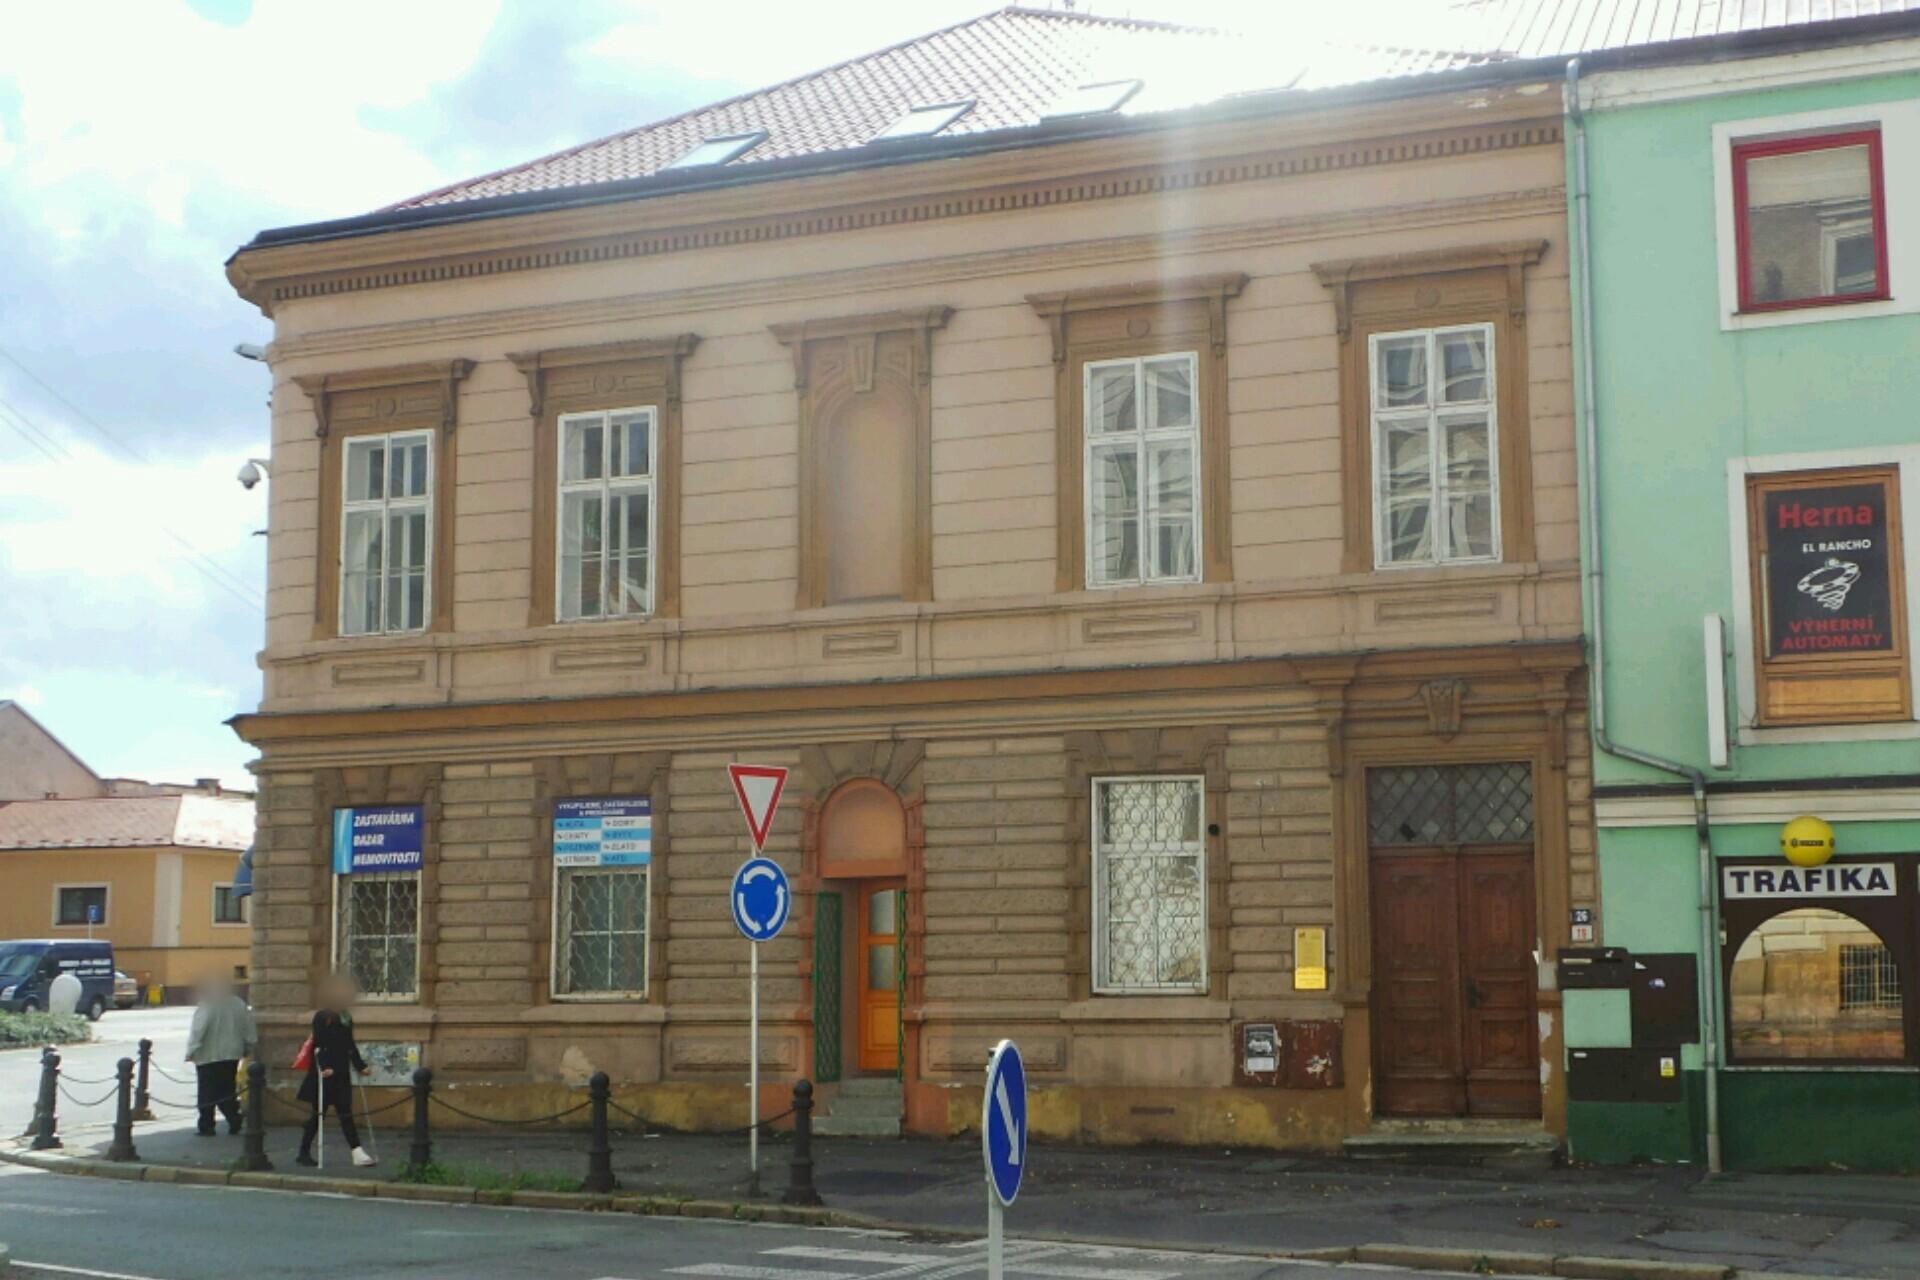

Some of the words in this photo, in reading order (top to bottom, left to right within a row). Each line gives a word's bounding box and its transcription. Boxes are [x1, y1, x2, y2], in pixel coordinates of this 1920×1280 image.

[1777, 503, 1873, 529] Herna
[1803, 542, 1816, 553] EL
[1818, 539, 1872, 552] RANCHO
[1789, 614, 1874, 633] VÝHERNÍ
[1782, 633, 1884, 649] AUTOMATY
[353, 810, 415, 828] ZASTAVÁRNA
[353, 833, 385, 847] BAZAR
[353, 851, 420, 866] NEMOVITOSTI
[1730, 867, 1890, 894] TRAFIKA
[1575, 910, 1589, 922] 26
